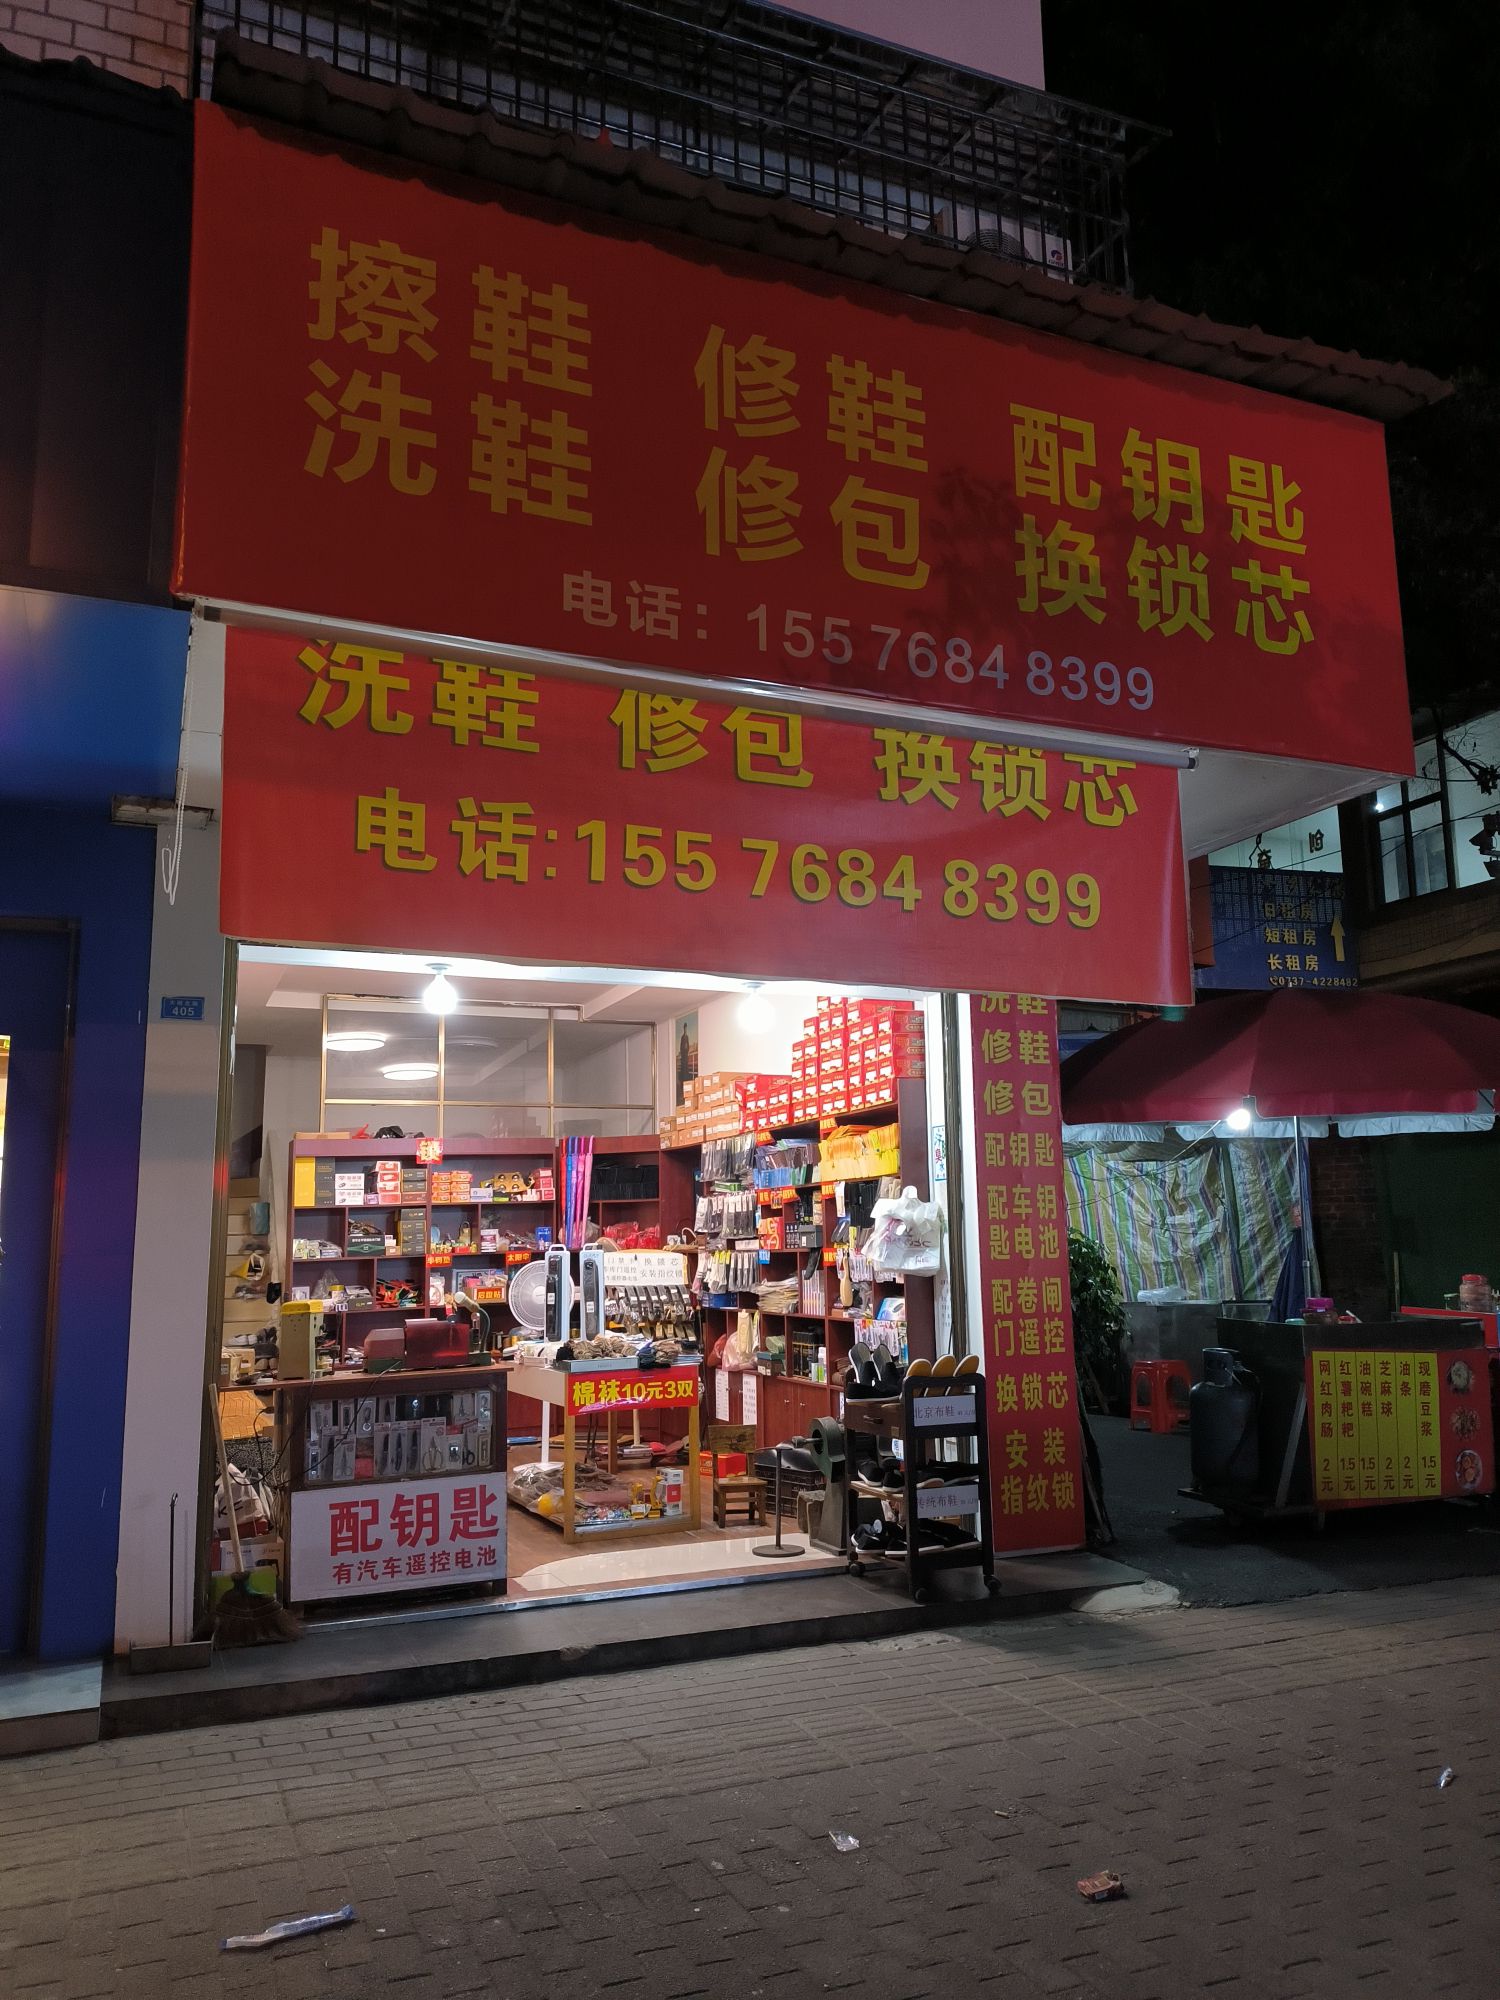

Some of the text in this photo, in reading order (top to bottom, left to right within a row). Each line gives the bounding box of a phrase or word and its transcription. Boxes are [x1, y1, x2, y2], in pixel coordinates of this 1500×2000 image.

[307, 226, 1307, 556] 擦鞋 修鞋 配钥匙
[303, 358, 1316, 657] 洗鞋 修包 换锁芯
[870, 624, 1011, 690] 7684
[1026, 651, 1155, 711] 8399
[741, 839, 924, 912] 7684
[941, 859, 1102, 929] 8399
[1264, 928, 1317, 946] 短租房
[1267, 954, 1320, 972] 长租房
[171, 1006, 195, 1017] 405
[981, 1028, 1051, 1065] 修鞋
[983, 1079, 1053, 1116] 修包
[984, 1132, 1055, 1168] 配钥匙
[987, 1183, 1058, 1220] 配车钥
[989, 1223, 1060, 1261] 匙电池
[991, 1277, 1063, 1317] 配卷闸
[994, 1319, 1066, 1358] 门遥控
[572, 1379, 695, 1408] 棉袜10元3双
[996, 1373, 1069, 1412] 换锁芯
[1000, 1474, 1076, 1516] 指纹锁
[328, 1484, 500, 1557] 配钥匙
[332, 1544, 498, 1585] 有汽车遥控电池
